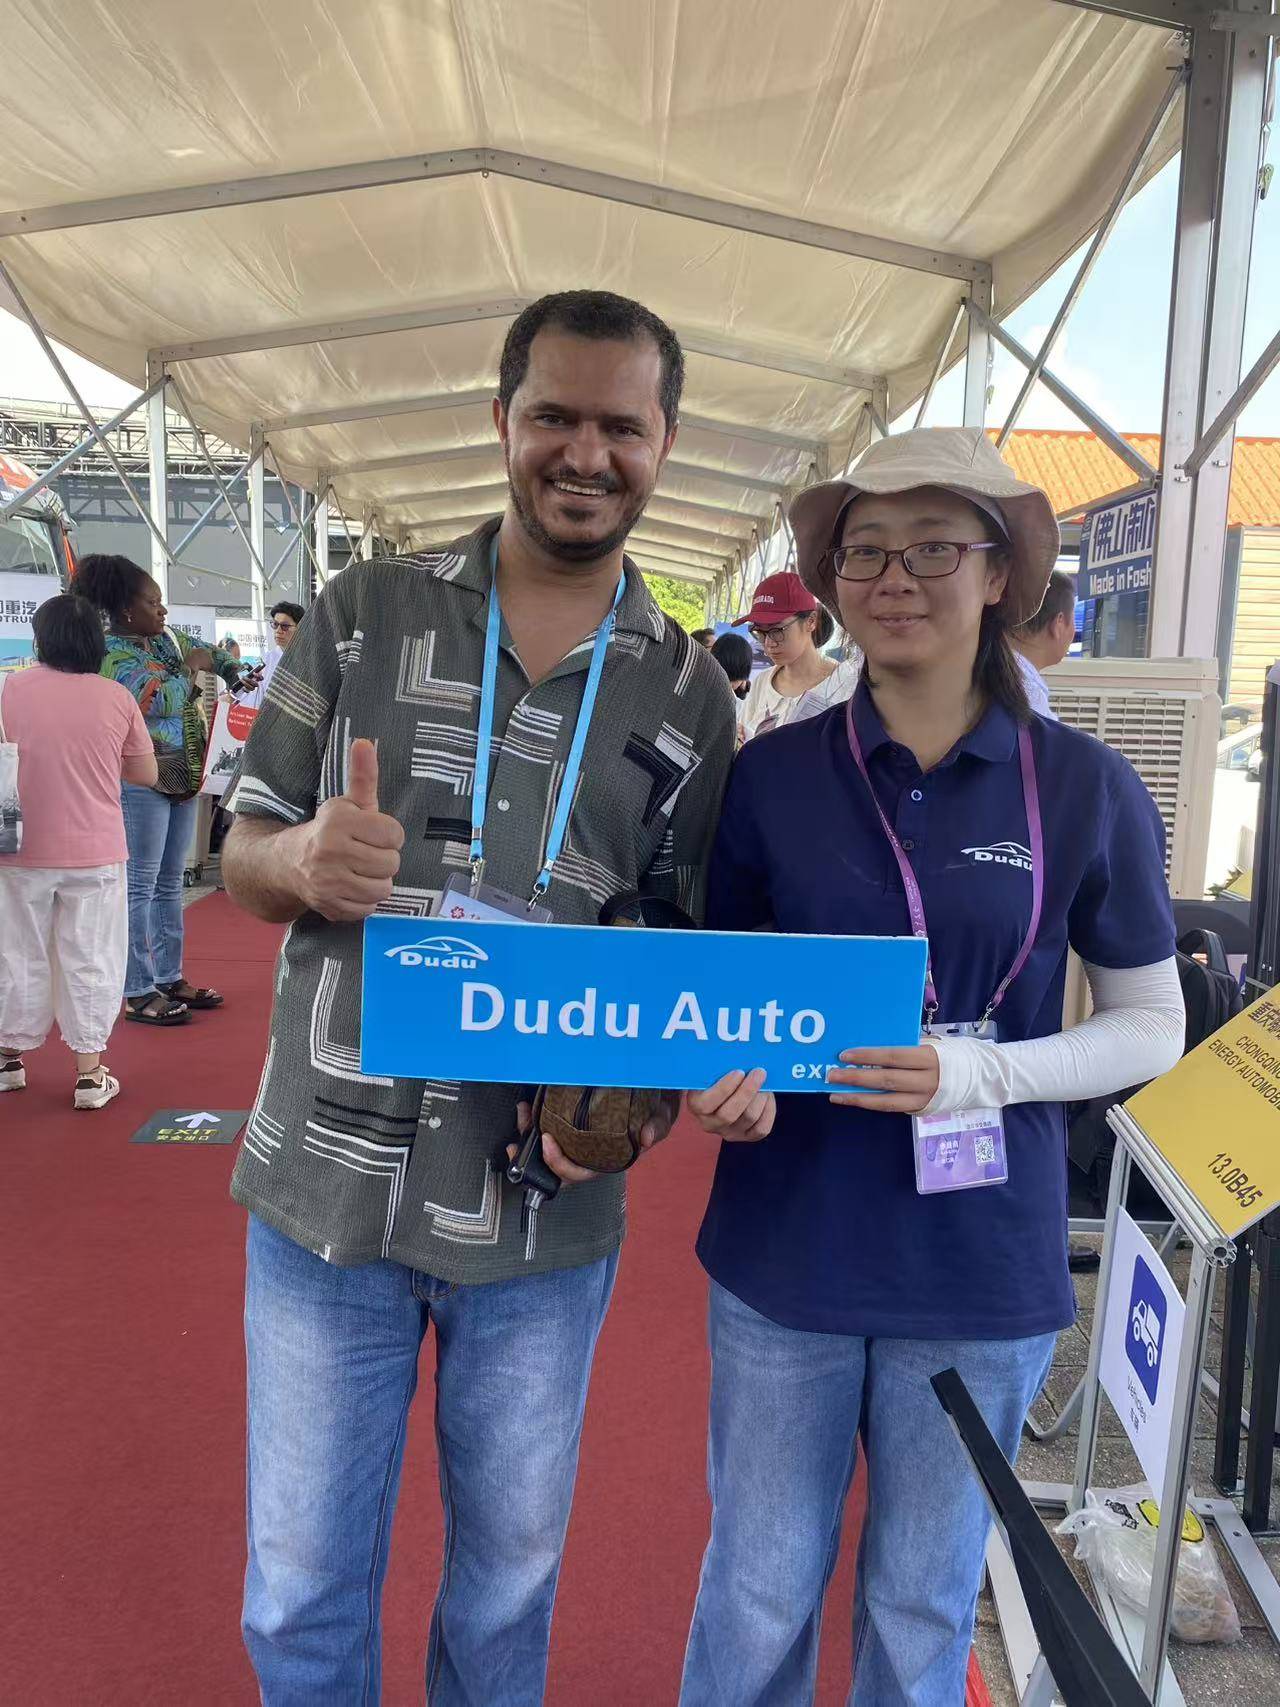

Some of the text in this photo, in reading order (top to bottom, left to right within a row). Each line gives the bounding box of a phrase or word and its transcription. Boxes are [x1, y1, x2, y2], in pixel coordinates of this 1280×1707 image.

[1090, 570, 1115, 596] Made
[1116, 568, 1125, 591] in
[0, 600, 37, 615] 重汽
[0, 615, 33, 623] TRU
[974, 851, 1033, 872] Dudu
[400, 951, 477, 969] Dudu
[460, 981, 826, 1044] Dudu Auto
[1208, 1039, 1244, 1069] ENERGY
[1208, 1152, 1263, 1208] 13.0B45
